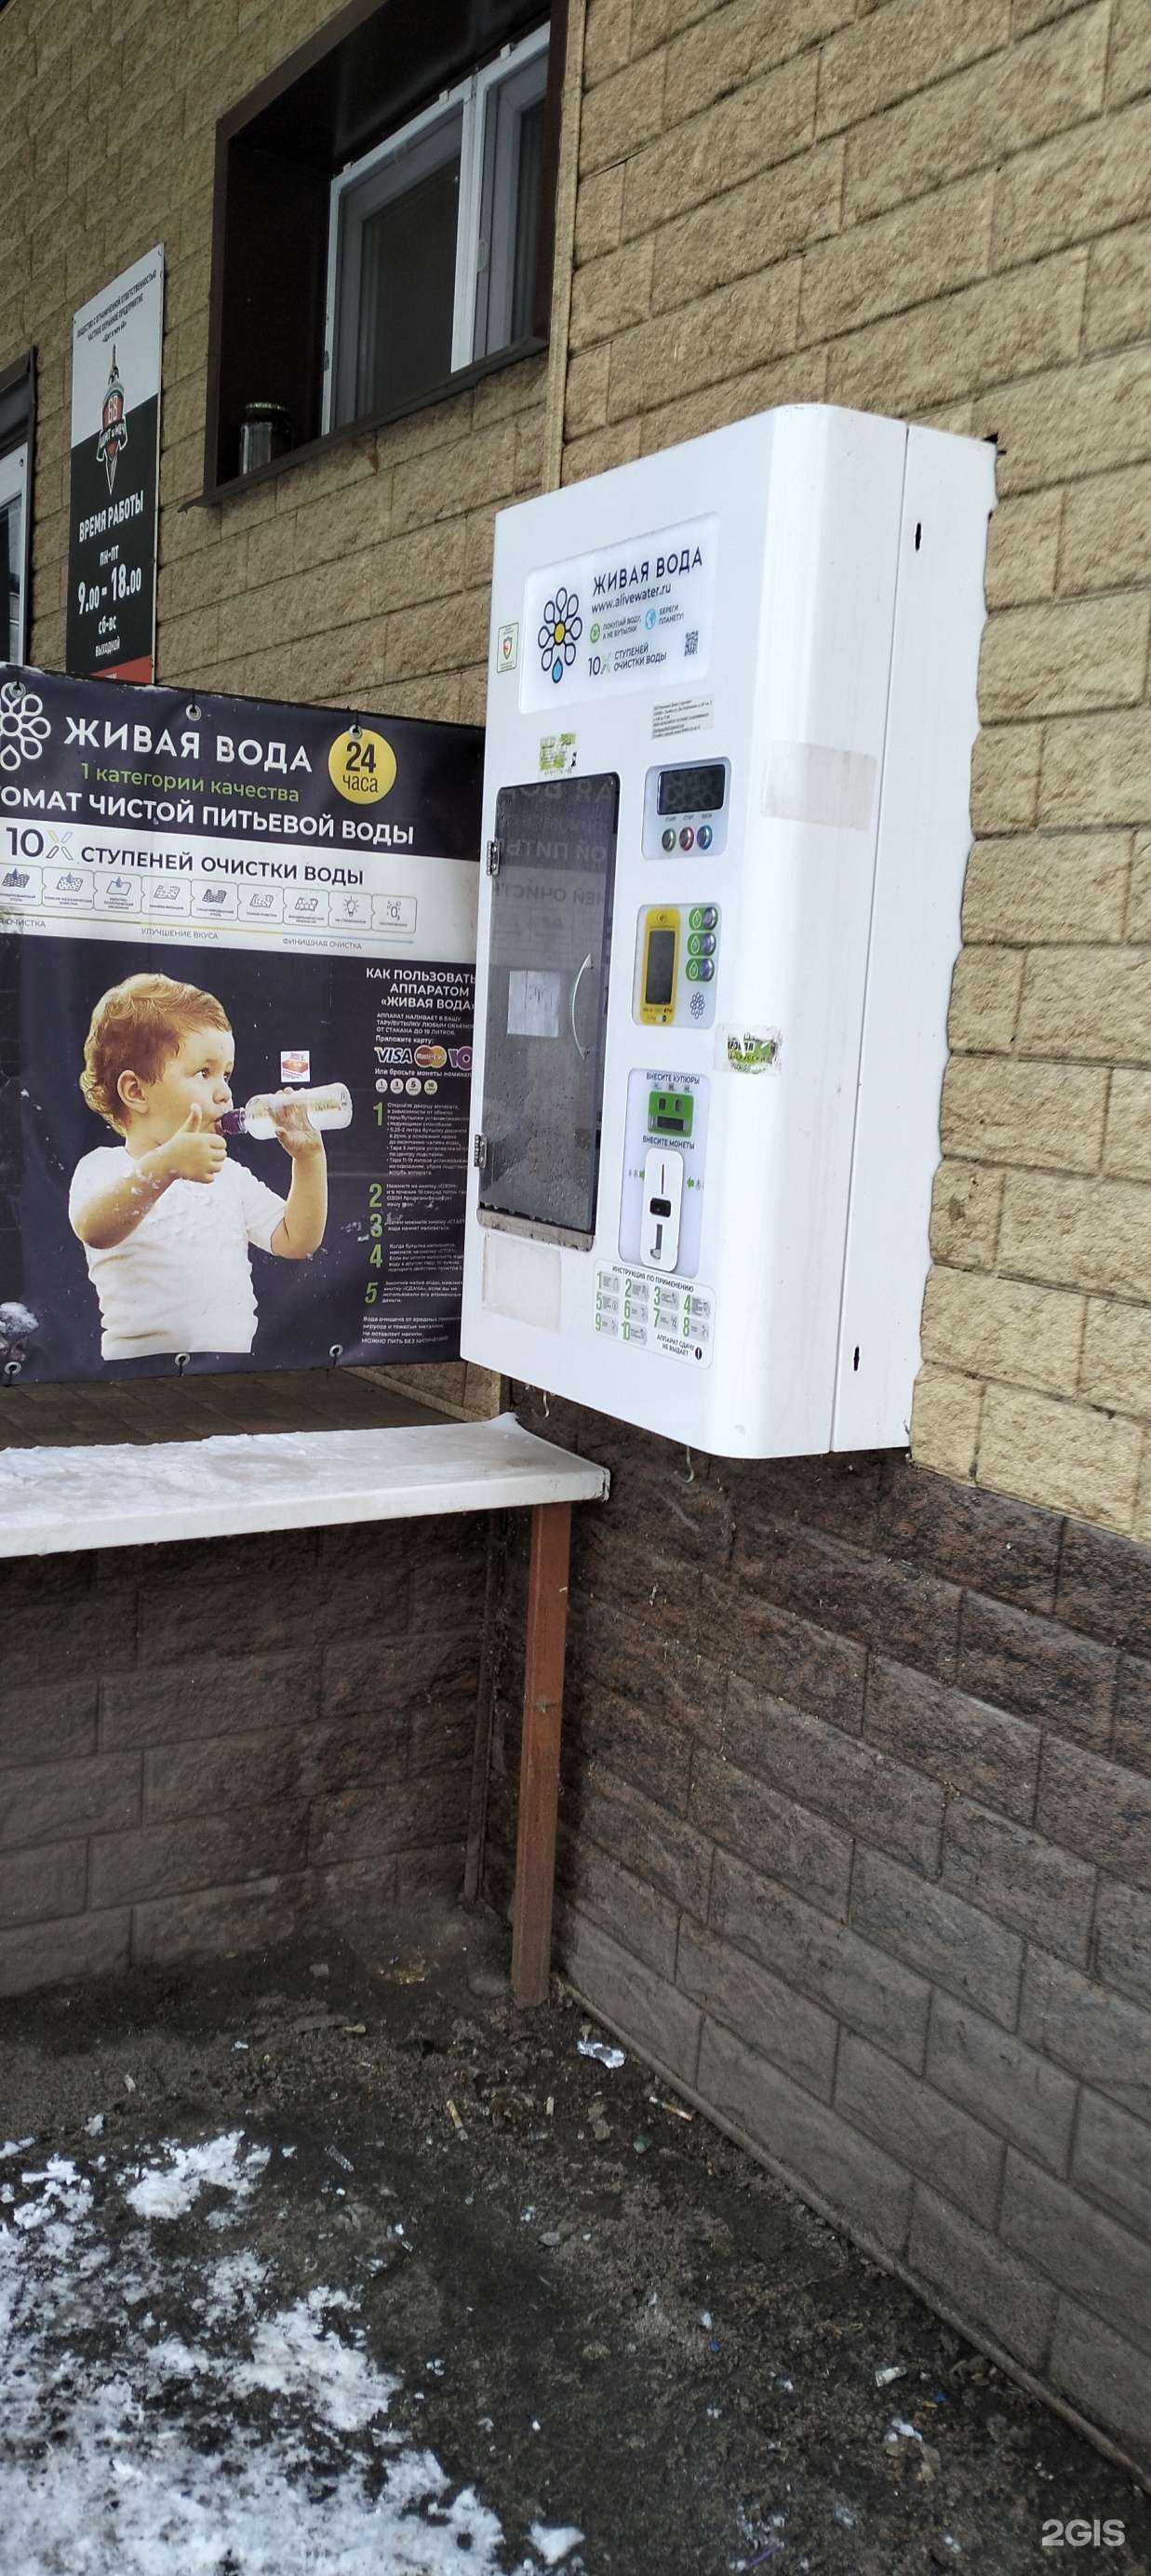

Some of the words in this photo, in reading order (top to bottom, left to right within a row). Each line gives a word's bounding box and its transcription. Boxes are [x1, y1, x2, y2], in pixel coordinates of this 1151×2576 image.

[79, 509, 107, 543] ВРЕМЯ
[108, 490, 144, 528] РАБОТЫ
[593, 561, 649, 597] ЖИВАЯ
[656, 546, 703, 578] ВОДА
[591, 584, 672, 614] www.alivewater.ru
[614, 642, 649, 660] СТУПЕНЕЙ
[613, 656, 645, 672] ОЧИСТКИ
[646, 651, 667, 664] ВОДЫ
[64, 717, 200, 759] ЖИВАЯ
[217, 734, 312, 774] ВОДА
[345, 742, 376, 773] 24
[81, 763, 89, 780] 1
[96, 768, 204, 792] категории
[210, 781, 300, 803] качества
[342, 774, 378, 793] часа
[0, 785, 82, 812] ОМАТ
[88, 793, 194, 824] ЧИСТОЙ
[202, 806, 334, 838] ПИТЬЕВОЙ
[341, 819, 414, 846] ВОДЫ
[81, 846, 194, 872] СТУПЕНЕЙ
[201, 856, 297, 880] ОЧИСТКИ
[304, 865, 364, 886] ВОДЫ
[141, 928, 192, 939] УЛУЧШЕНИЕ
[194, 932, 219, 940] ВКУСА
[283, 937, 328, 947] ФИНИШНАЯ
[329, 941, 362, 950] ОЧИСТКА
[367, 968, 391, 980] КАК
[390, 983, 469, 997] АППАРАТОМ
[381, 996, 433, 1009] «ЖИВАЯ
[376, 1035, 411, 1043] Приложите
[374, 1046, 413, 1064] VISA
[647, 1071, 672, 1081] ВНЕСИТЕ
[673, 1074, 700, 1084] КУПЮРЫ
[373, 1102, 383, 1126] 1
[642, 1135, 668, 1147] ВНЕСИТЕ
[669, 1139, 695, 1149] МОНЕТЫ
[368, 1183, 382, 1208] 2
[370, 1214, 382, 1237] 3
[369, 1243, 383, 1268] 4
[597, 1270, 602, 1289] 1
[612, 1266, 646, 1280] ИНСТРУКЦИЯ
[647, 1274, 655, 1282] ПО
[655, 1276, 694, 1293] ПРИМЕНЕНИЮ
[624, 1278, 632, 1298] 2
[365, 1281, 379, 1303] 5
[596, 1292, 602, 1310] 5
[653, 1286, 661, 1306] 3
[623, 1299, 630, 1319] 6
[684, 1295, 690, 1315] 4
[596, 1313, 601, 1332] 9
[653, 1308, 660, 1328] 7
[682, 1317, 689, 1336] 8
[622, 1322, 631, 1340] 10
[656, 1334, 678, 1347] АППАРАТ
